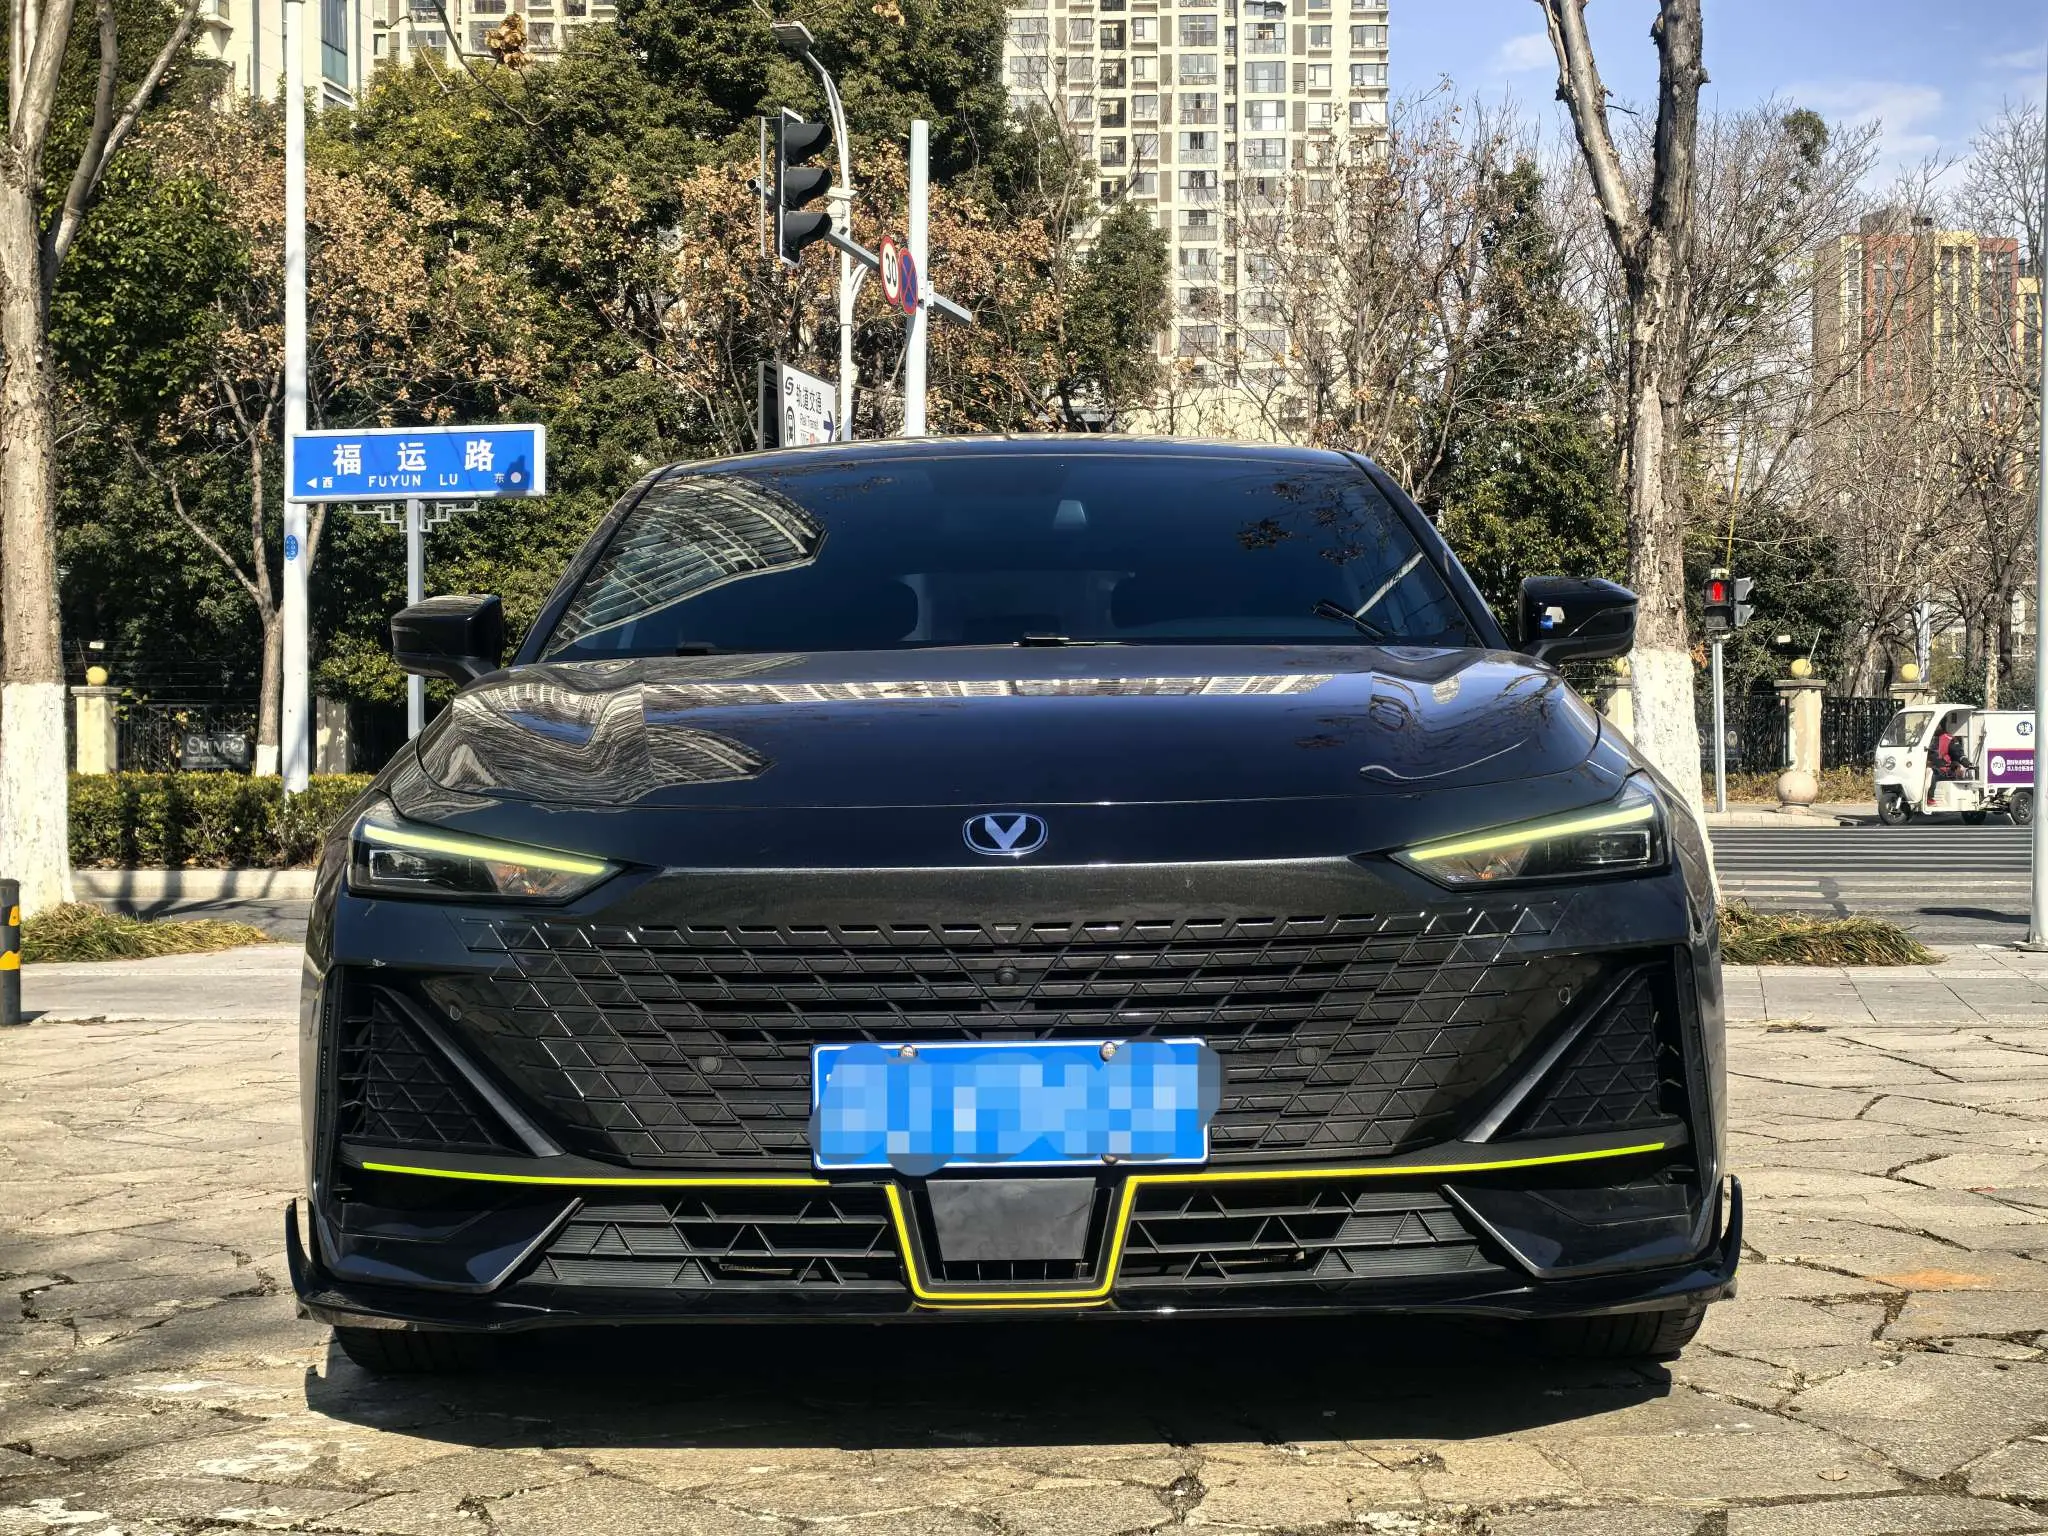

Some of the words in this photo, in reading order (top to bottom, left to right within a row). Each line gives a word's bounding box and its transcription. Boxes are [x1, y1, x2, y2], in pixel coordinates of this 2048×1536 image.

[886, 252, 897, 287] 30
[796, 383, 822, 415] 轨道交通
[333, 439, 495, 476] 福运路
[322, 476, 333, 489] 西
[368, 473, 421, 487] FUYUN
[440, 473, 458, 486] LU
[494, 472, 505, 483] 东
